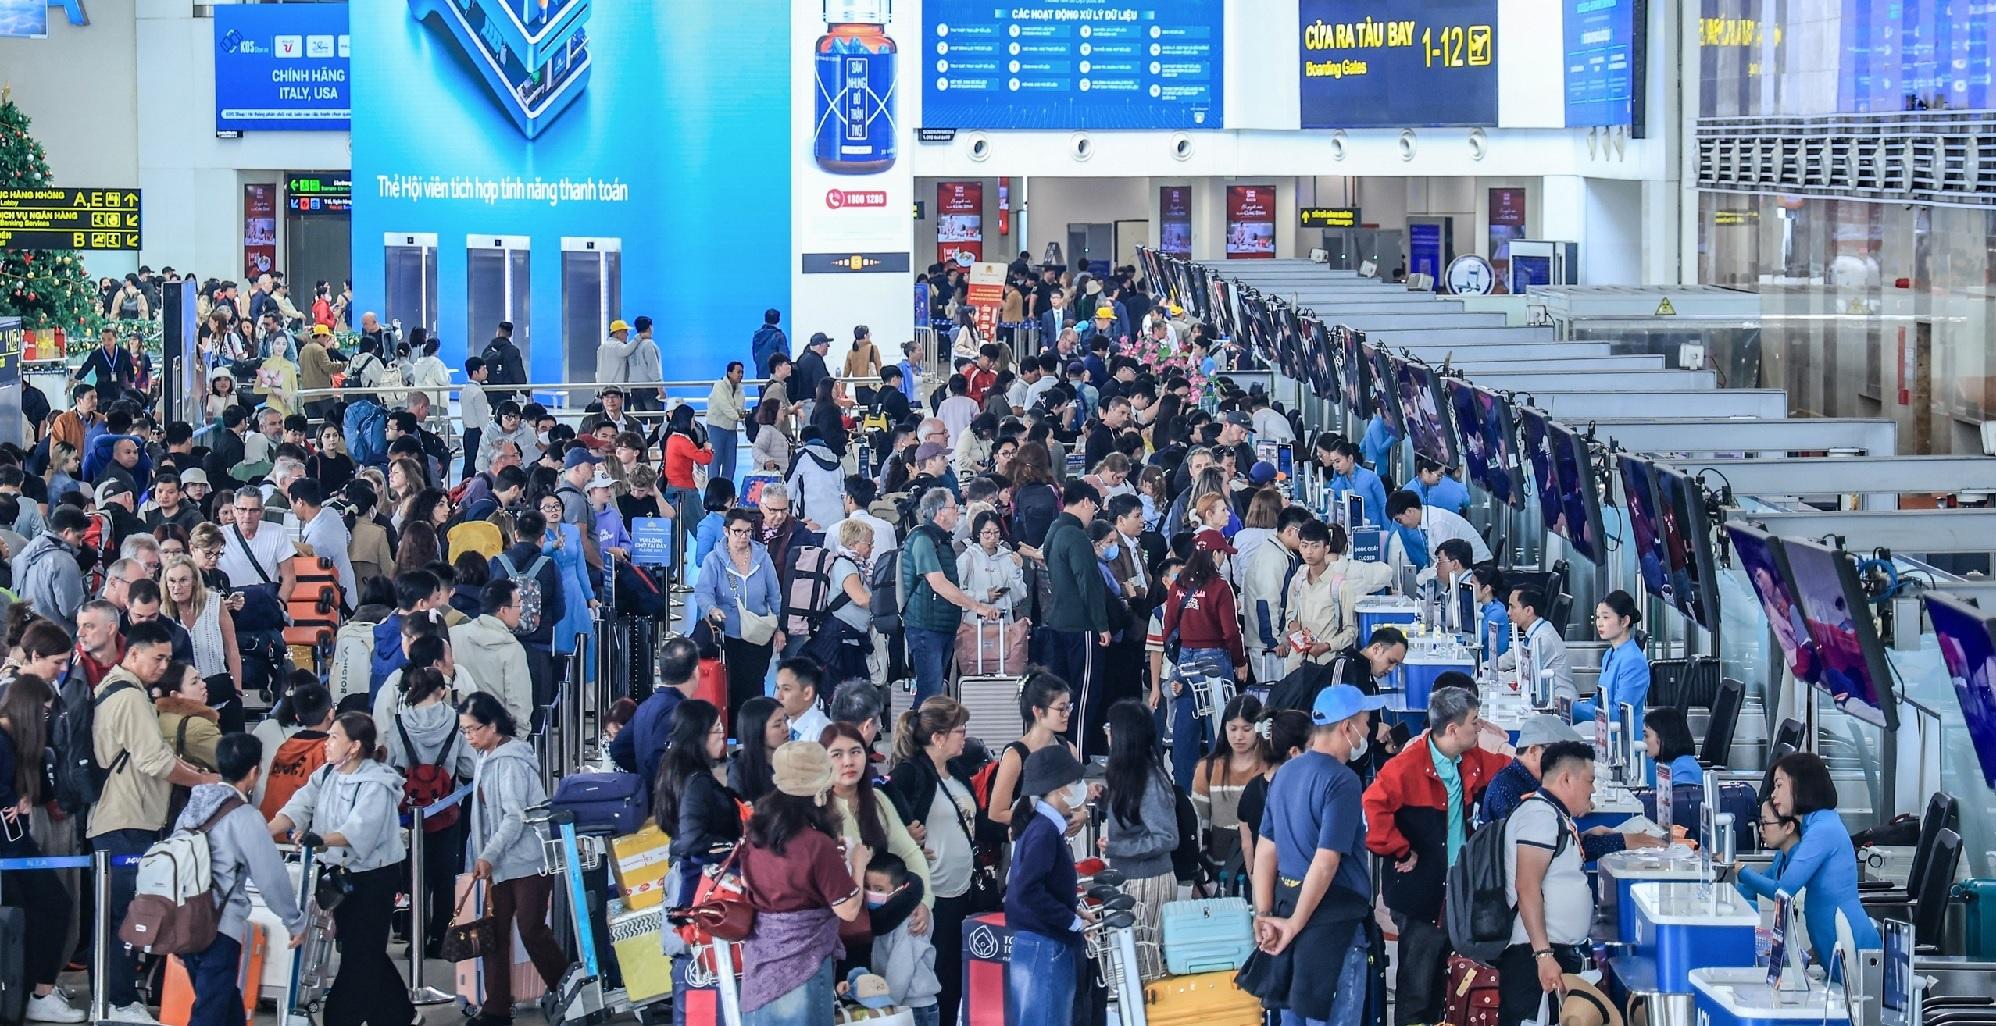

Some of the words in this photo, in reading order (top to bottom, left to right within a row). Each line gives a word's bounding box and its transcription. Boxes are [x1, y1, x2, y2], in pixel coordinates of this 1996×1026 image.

[1011, 8, 1030, 20] CÁC
[1031, 9, 1053, 21] HOẠT
[1055, 8, 1079, 22] ĐỘNG
[1093, 8, 1104, 20] LÝ
[1118, 8, 1138, 22] LIỆU
[1305, 19, 1335, 50] CỬA
[1336, 24, 1356, 49] RA
[1356, 16, 1385, 48] TÀU
[1387, 21, 1415, 47] BAY
[1421, 26, 1464, 68] 1-12
[272, 66, 309, 82] CHÍNH
[312, 66, 346, 82] HÃNG
[1305, 60, 1342, 78] Boarding
[1342, 59, 1367, 76] Gates
[279, 86, 311, 102] ITALY,
[314, 86, 338, 99] USA
[10, 189, 35, 200] HÀNG
[35, 190, 65, 200] KHÔNG
[377, 173, 400, 199] Thẻ
[401, 175, 422, 202] Hội
[425, 177, 449, 199] viên
[451, 175, 474, 199] tích
[475, 176, 499, 205] hợp
[501, 177, 524, 200] tính
[526, 176, 558, 207] năng
[559, 177, 597, 201] thanh
[598, 177, 629, 202] toán
[55, 210, 78, 220] HÀNG
[73, 232, 85, 248] B
